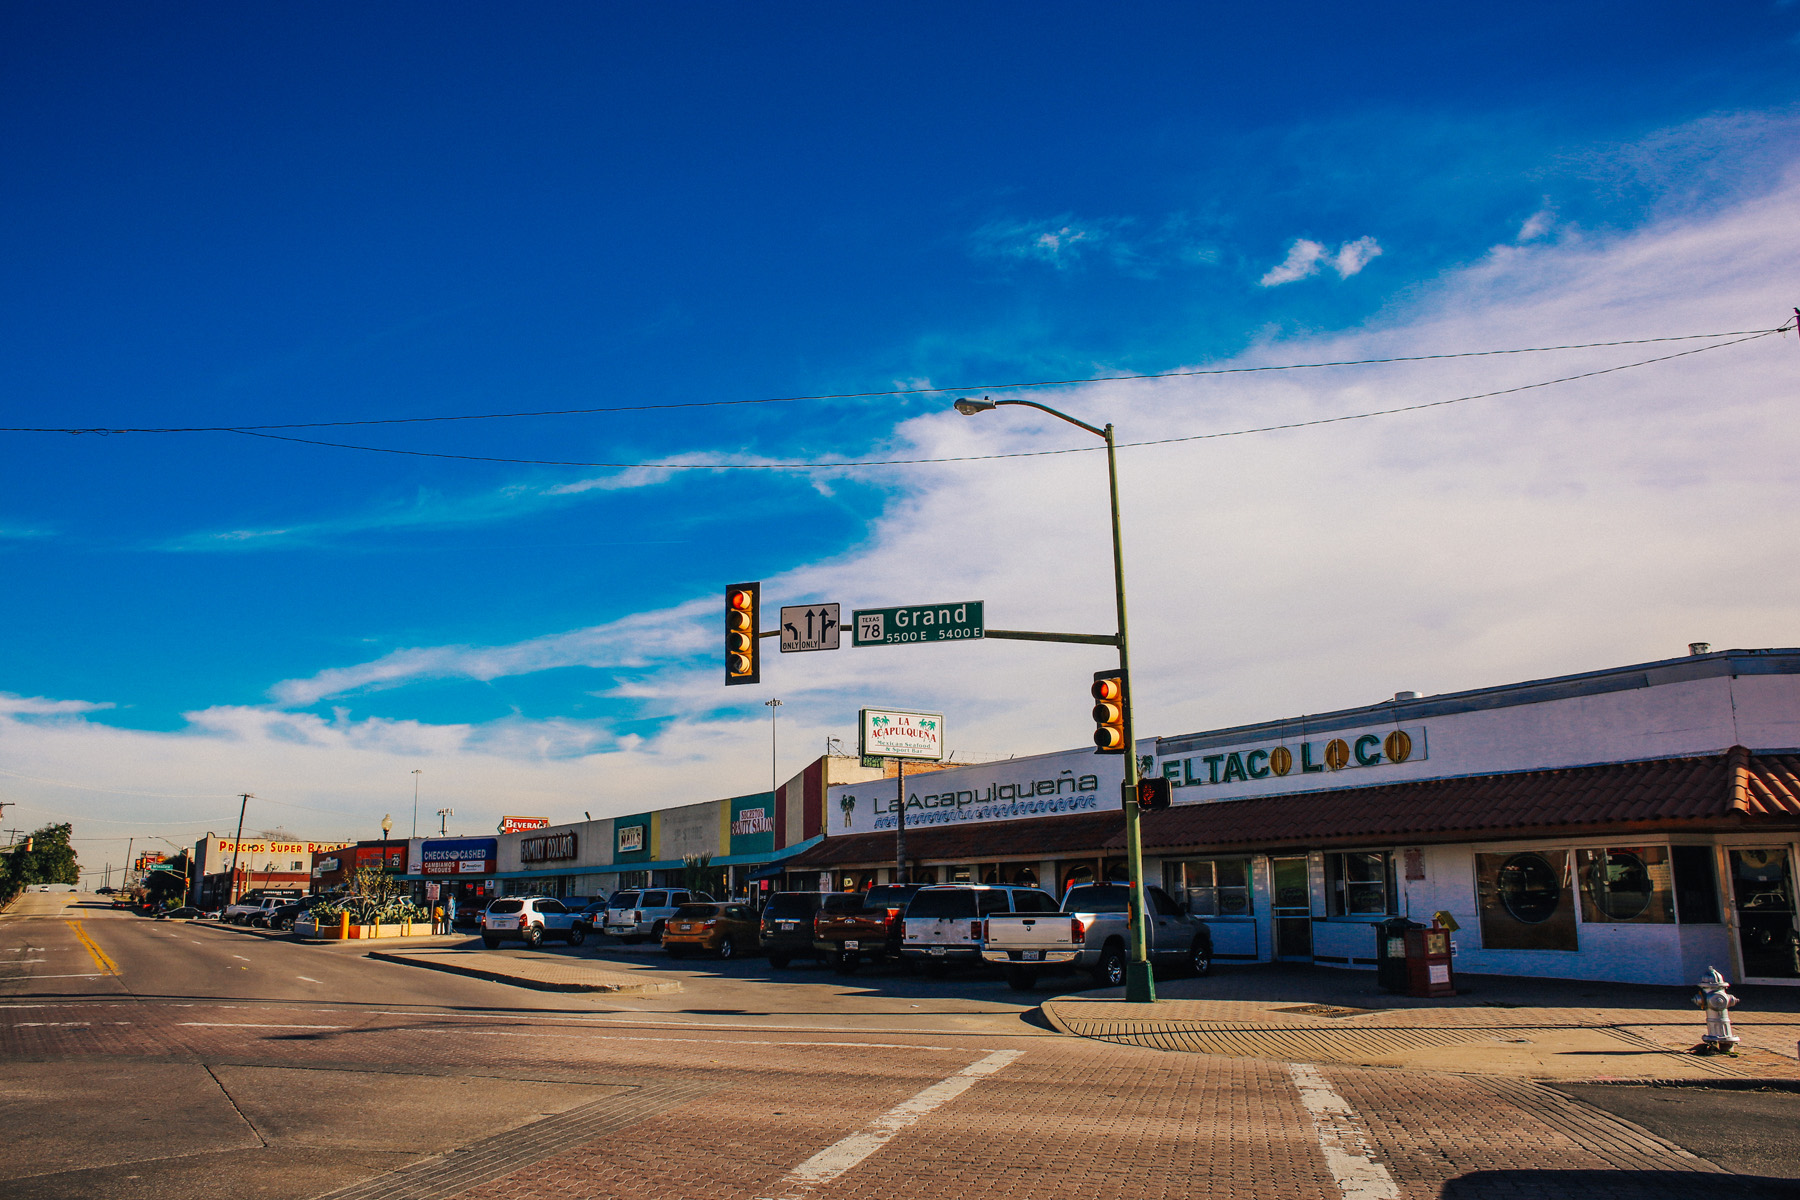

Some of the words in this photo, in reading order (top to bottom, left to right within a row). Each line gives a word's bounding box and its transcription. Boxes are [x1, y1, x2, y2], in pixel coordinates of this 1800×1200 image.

[895, 604, 966, 627] Grand
[861, 624, 880, 638] 78
[886, 632, 917, 643] 5500
[920, 631, 927, 640] E
[939, 628, 971, 639] 5400
[973, 627, 980, 637] E
[783, 642, 799, 650] ONLY
[898, 717, 910, 726] LA
[871, 727, 936, 742] ACAPULQUEÑA
[1162, 758, 1201, 787] EL
[1203, 746, 1292, 784] TACO
[1301, 730, 1412, 773] LOCO
[904, 769, 1098, 811] Acapulqueña
[752, 817, 774, 834] SALON
[219, 841, 265, 852] PRECIOS
[270, 841, 302, 853] SUPER
[620, 832, 641, 847] NAILS
[424, 850, 450, 860] CHECKS
[460, 849, 486, 859] CASHED
[521, 838, 545, 861] FAMILY
[547, 835, 574, 859] DOLLAR
